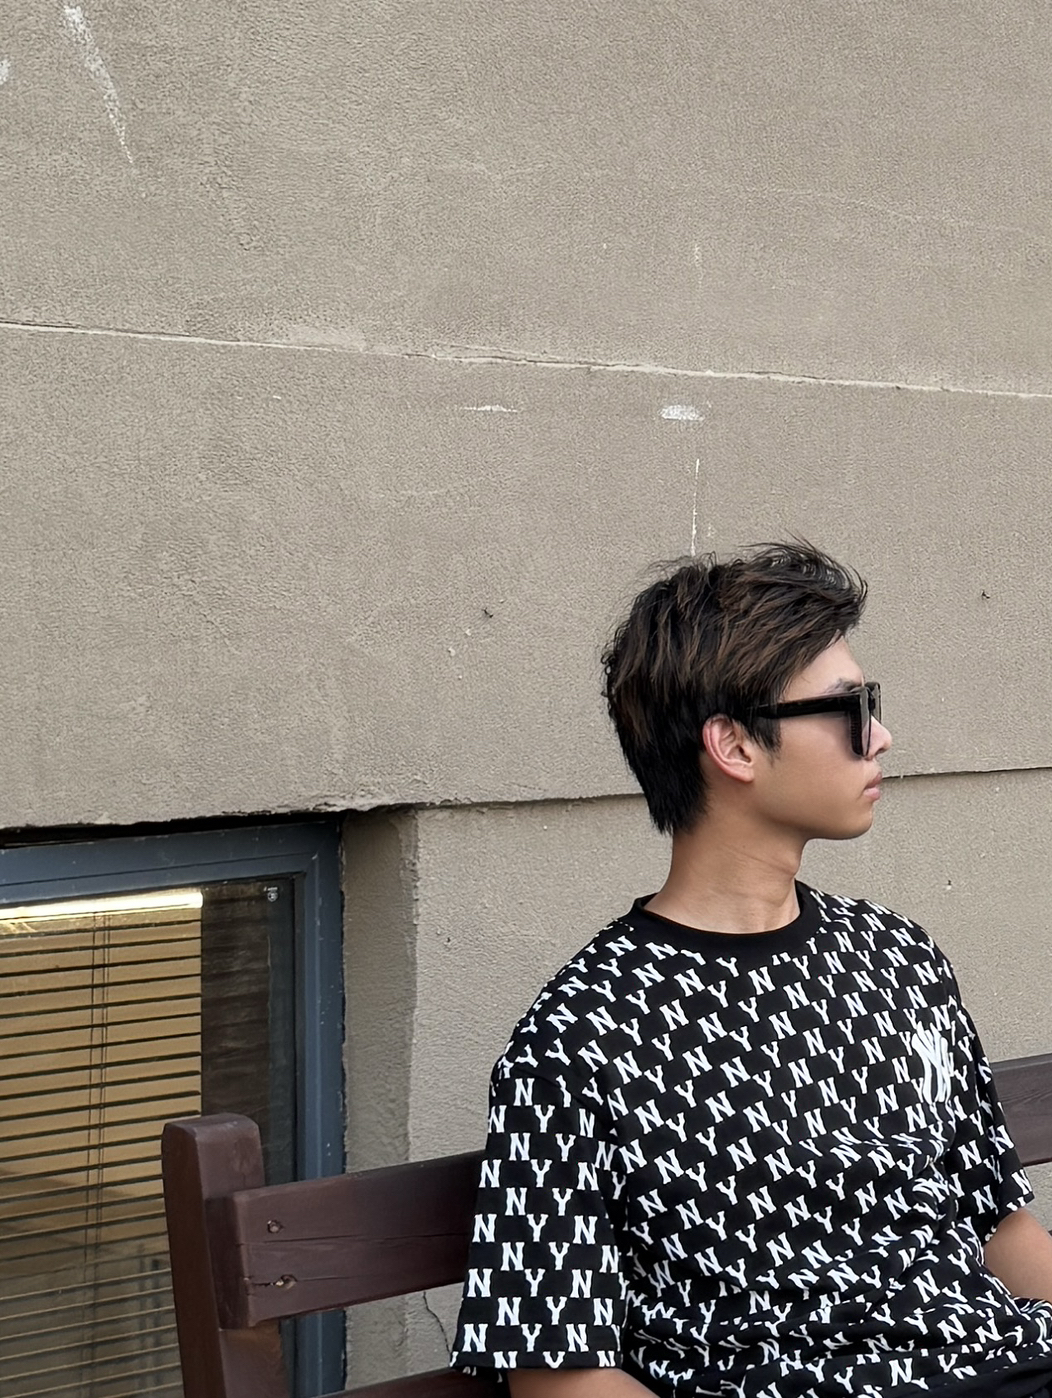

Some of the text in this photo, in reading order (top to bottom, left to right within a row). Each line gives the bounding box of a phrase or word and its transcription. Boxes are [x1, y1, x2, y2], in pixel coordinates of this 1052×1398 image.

[833, 932, 855, 952] N
[860, 931, 876, 951] Y
[558, 976, 589, 997] N
[591, 962, 665, 1002] Y N
[880, 961, 939, 988] Y N
[586, 957, 739, 1035] N Y N Y
[620, 947, 908, 1046] Y N Y N Y N Y N
[546, 1003, 578, 1033] N
[613, 971, 877, 1084] N Y N Y N Y N
[931, 1004, 952, 1031] N
[545, 1038, 571, 1065] Y
[644, 985, 928, 1093] Y N Y N Y N Y N
[958, 1036, 973, 1061] Y
[578, 1040, 608, 1072] N
[674, 1011, 897, 1108] Y N Y N Y N
[513, 1078, 534, 1106] N
[582, 1077, 603, 1105] Y
[666, 1112, 687, 1142] Y
[705, 1091, 736, 1123] N
[752, 1070, 774, 1097] Y
[788, 1058, 813, 1088] N
[828, 1046, 845, 1073] Y
[861, 1037, 885, 1064] N
[954, 1065, 969, 1091] Y
[634, 1099, 664, 1134] N
[695, 1056, 910, 1156] Y N Y N Y N
[863, 1103, 927, 1139] Y N
[534, 1105, 555, 1133] Y
[579, 1109, 595, 1138] N
[969, 1110, 984, 1135] Y
[509, 1133, 576, 1162] N Y
[595, 1141, 617, 1171] N
[619, 1139, 647, 1173] N
[637, 1189, 667, 1218] N
[685, 1162, 707, 1192] Y
[726, 1137, 757, 1171] N
[804, 1108, 826, 1138] N
[840, 1097, 857, 1124] Y
[876, 1084, 899, 1114] N
[958, 1140, 982, 1170] N
[479, 1159, 599, 1191] N Y N
[654, 1149, 684, 1184] N
[764, 1147, 794, 1181] N
[796, 1160, 817, 1188] Y
[826, 1146, 895, 1200] Y N
[716, 1175, 738, 1205] Y
[1011, 1169, 1032, 1195] N
[505, 1187, 573, 1216] N Y
[675, 1199, 704, 1229] N
[705, 1211, 727, 1240] Y
[747, 1186, 776, 1220] N
[784, 1195, 811, 1227] N
[813, 1181, 877, 1233] Y N
[841, 1187, 911, 1245] Y N
[472, 1214, 597, 1244] N Y N
[735, 1224, 757, 1252] Y
[501, 1242, 621, 1273] N Y N
[694, 1247, 723, 1276] N
[725, 1232, 795, 1288] Y N
[756, 1240, 833, 1289] Y N
[467, 1268, 592, 1298] N Y N
[827, 1263, 881, 1292] N Y
[913, 1269, 940, 1303] N
[942, 1280, 968, 1303] Y
[496, 1296, 613, 1326] N Y N
[871, 1303, 895, 1326] Y
[462, 1324, 488, 1352] N
[521, 1324, 542, 1352] Y
[937, 1314, 967, 1344] N
[834, 1367, 853, 1393] Y
